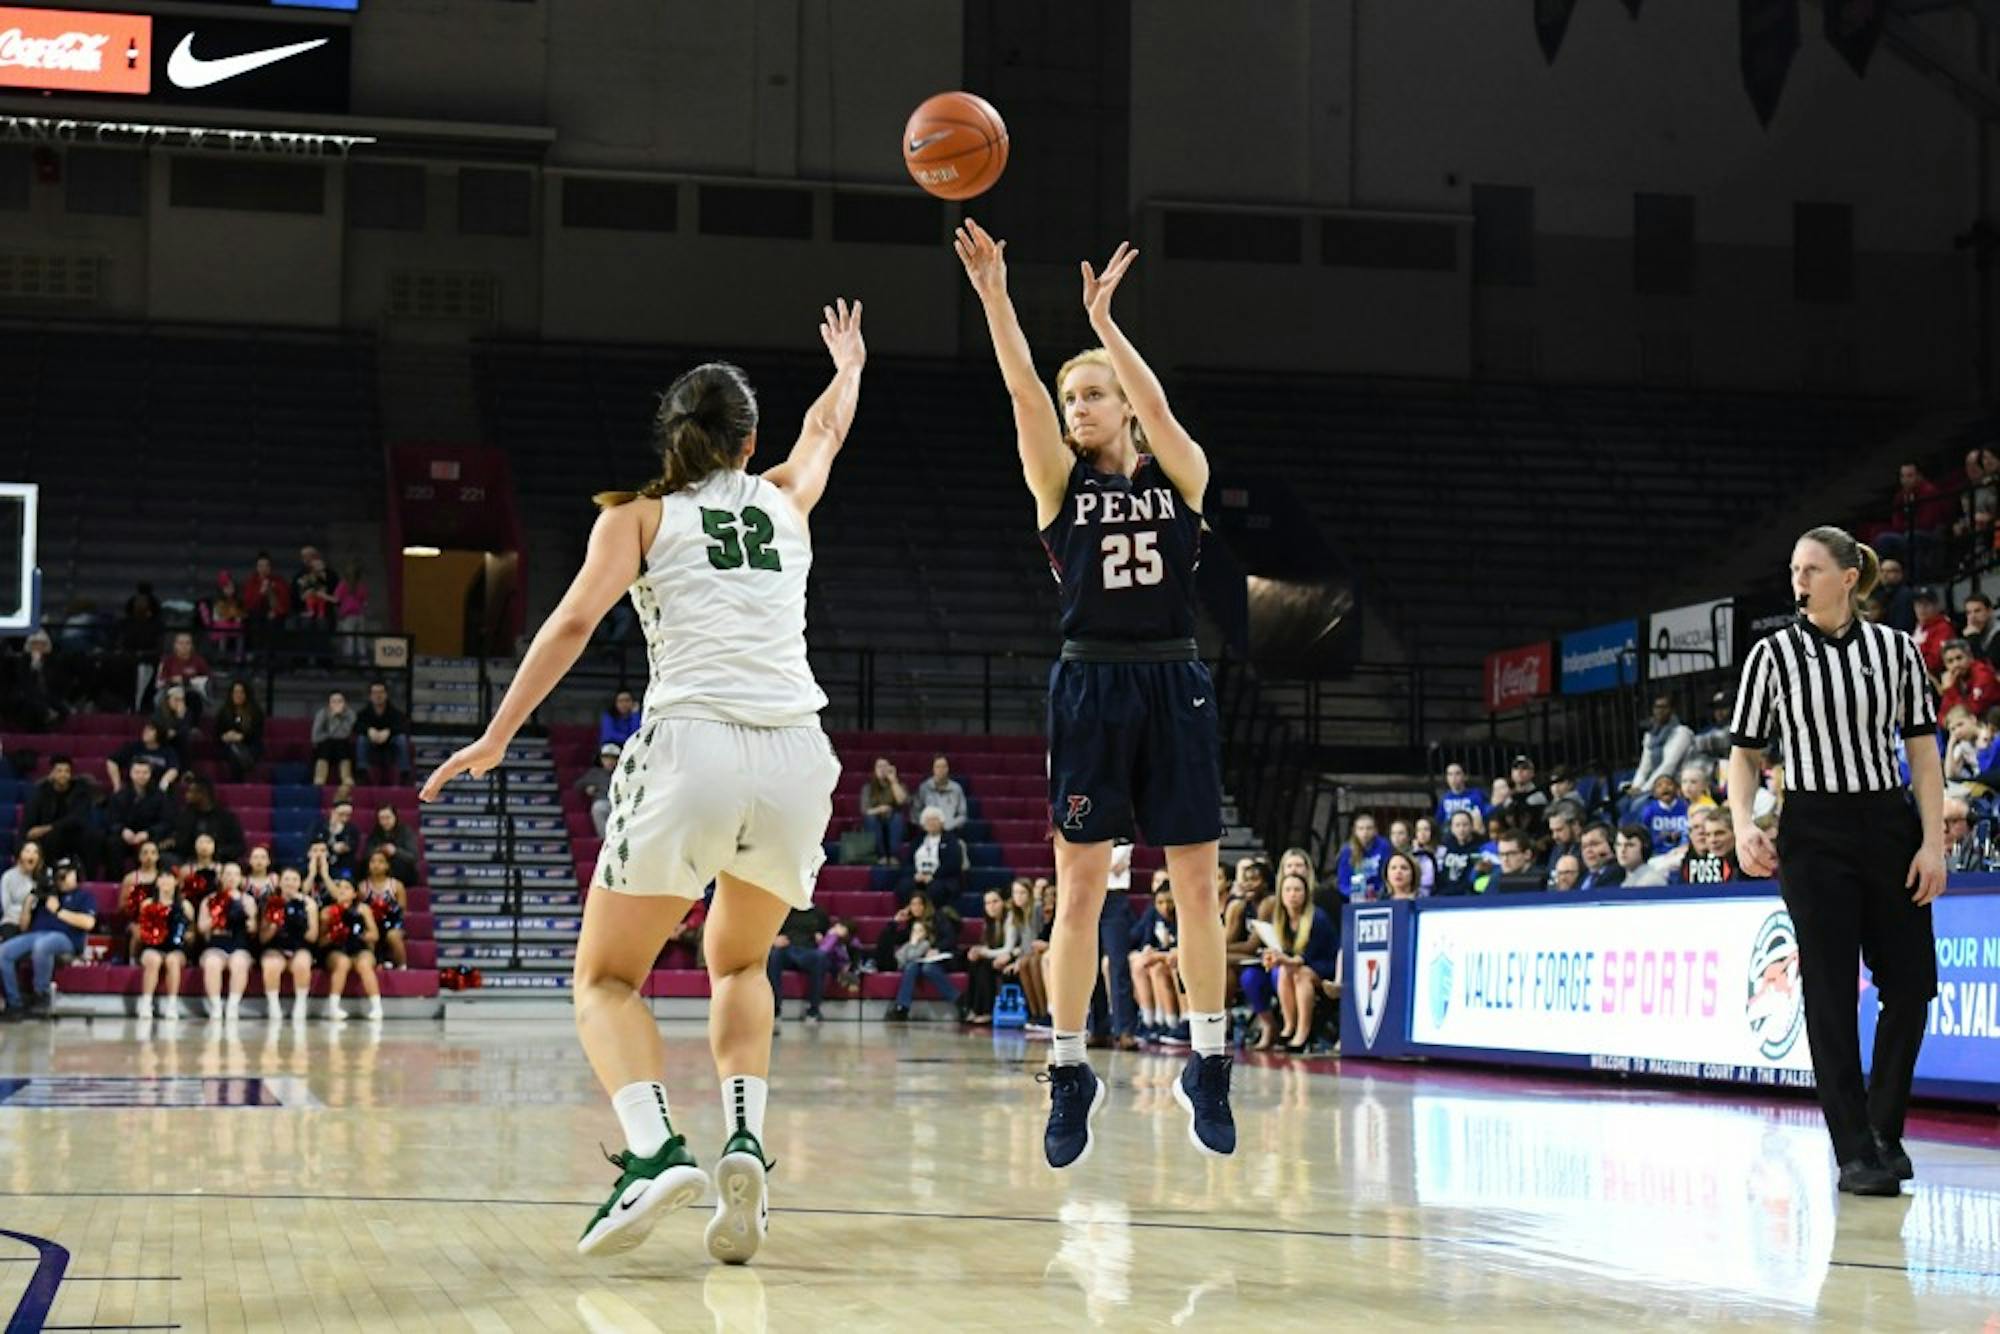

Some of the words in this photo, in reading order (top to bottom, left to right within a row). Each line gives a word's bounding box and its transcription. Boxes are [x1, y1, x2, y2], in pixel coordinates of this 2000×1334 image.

[1074, 487, 1176, 526] PENN
[699, 505, 782, 572] 52
[1101, 531, 1164, 589] 25
[1673, 625, 1727, 646] MACQUAIE
[1063, 794, 1092, 829] P
[1358, 919, 1389, 944] PENN
[1465, 952, 1528, 1010] VALLEY
[1534, 952, 1595, 1012] FORGE
[1602, 950, 1719, 1018] SPORTS
[1590, 1055, 1630, 1070] WELCOME
[1633, 1058, 1646, 1073] TO
[1703, 1063, 1734, 1080] COURT
[1738, 1066, 1752, 1082] AT
[1756, 1067, 1776, 1084] THE
